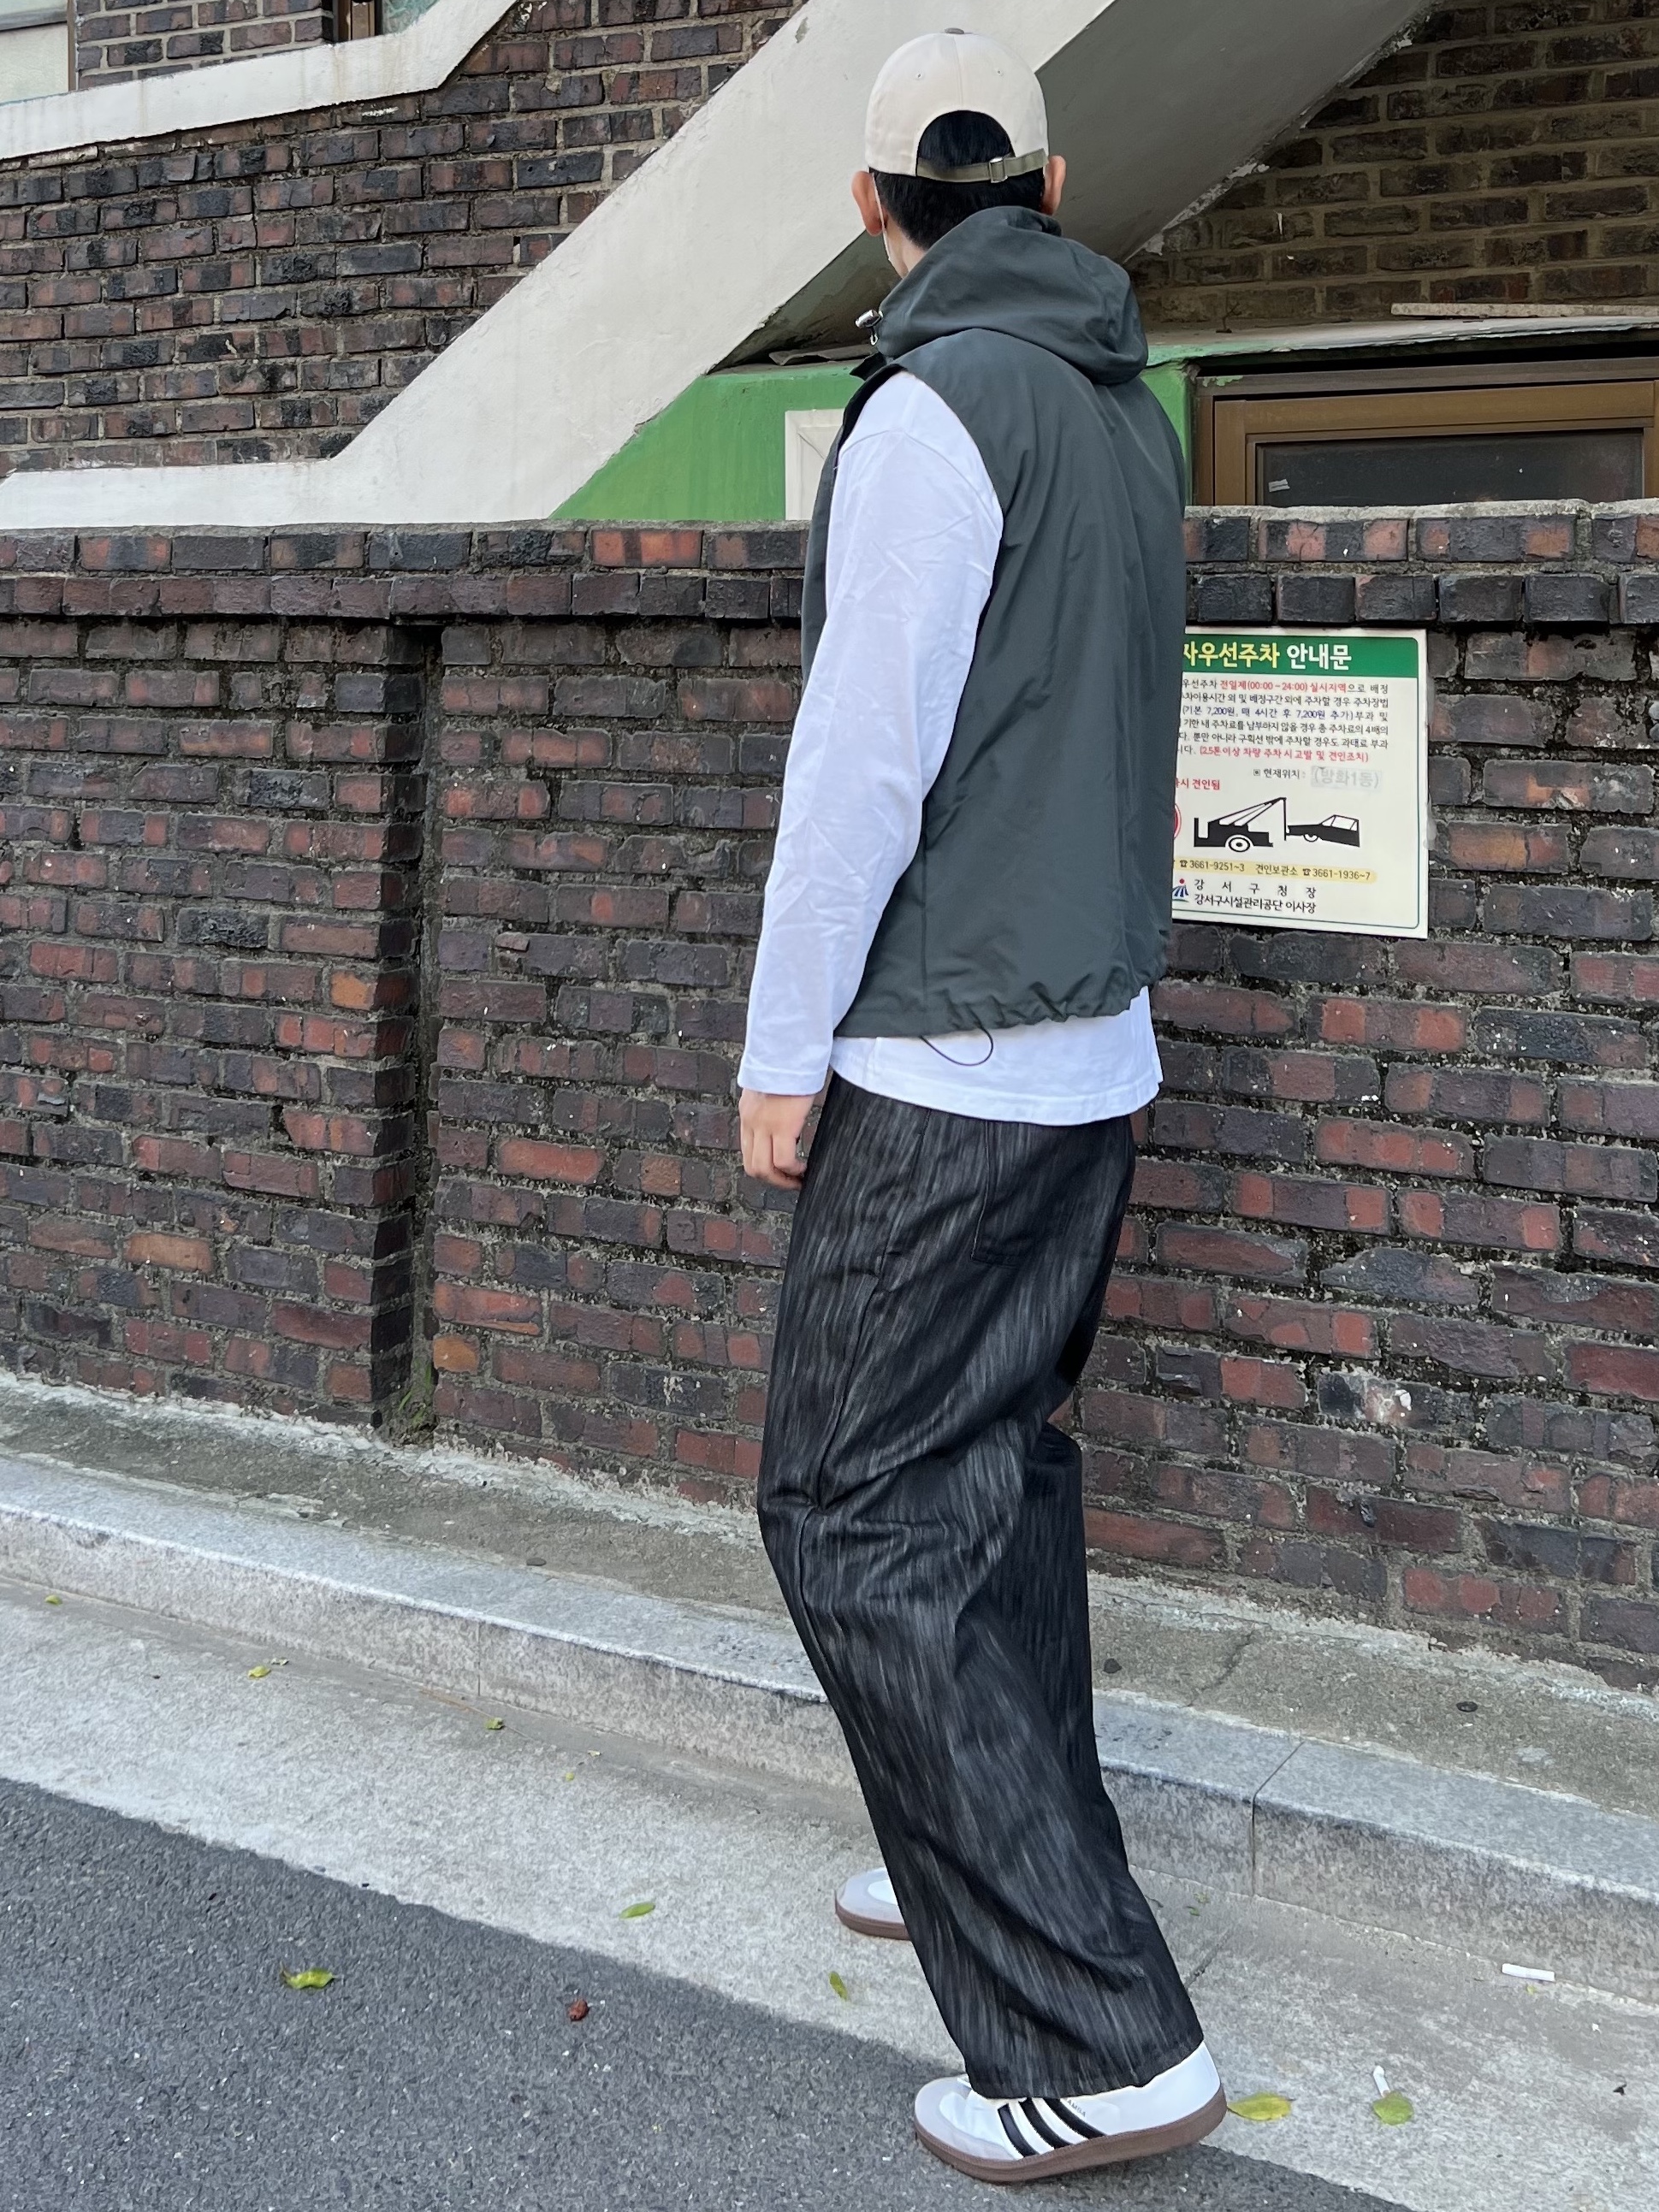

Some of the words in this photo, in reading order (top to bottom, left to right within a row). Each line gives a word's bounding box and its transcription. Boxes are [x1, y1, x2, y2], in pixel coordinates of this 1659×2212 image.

[1286, 642, 1352, 671] 안내문
[1371, 683, 1389, 695] 배정
[1239, 695, 1247, 704] 및
[1249, 695, 1283, 705] 배정구간
[1305, 696, 1330, 707] 주차할
[1334, 697, 1350, 707] 경우
[1354, 697, 1389, 708] 주차장법
[1255, 708, 1277, 718] 4시간
[1283, 709, 1291, 719] 후
[1379, 712, 1388, 722] 및
[1212, 719, 1244, 730] 주차료를
[1247, 721, 1279, 731] 납부하지
[1281, 722, 1298, 733] 않을
[1301, 723, 1316, 733] 경우
[1329, 725, 1363, 735] 주차료의
[1194, 732, 1209, 742] 뿐만
[1212, 732, 1236, 743] 아니라
[1239, 734, 1264, 744] 구획선
[1265, 734, 1283, 746] 밖에
[1285, 736, 1311, 747] 주차할
[1314, 737, 1339, 748] 경우도
[1342, 738, 1367, 748] 과태료
[1371, 739, 1389, 749] 부과
[1243, 748, 1261, 758] 차량
[1264, 748, 1282, 759] 주차
[1295, 749, 1312, 760] 고발
[1316, 750, 1324, 761] 및
[1255, 863, 1299, 876] 견인보관소
[1194, 894, 1283, 912] 강서구시설관리공단
[1285, 901, 1317, 914] 이사장
